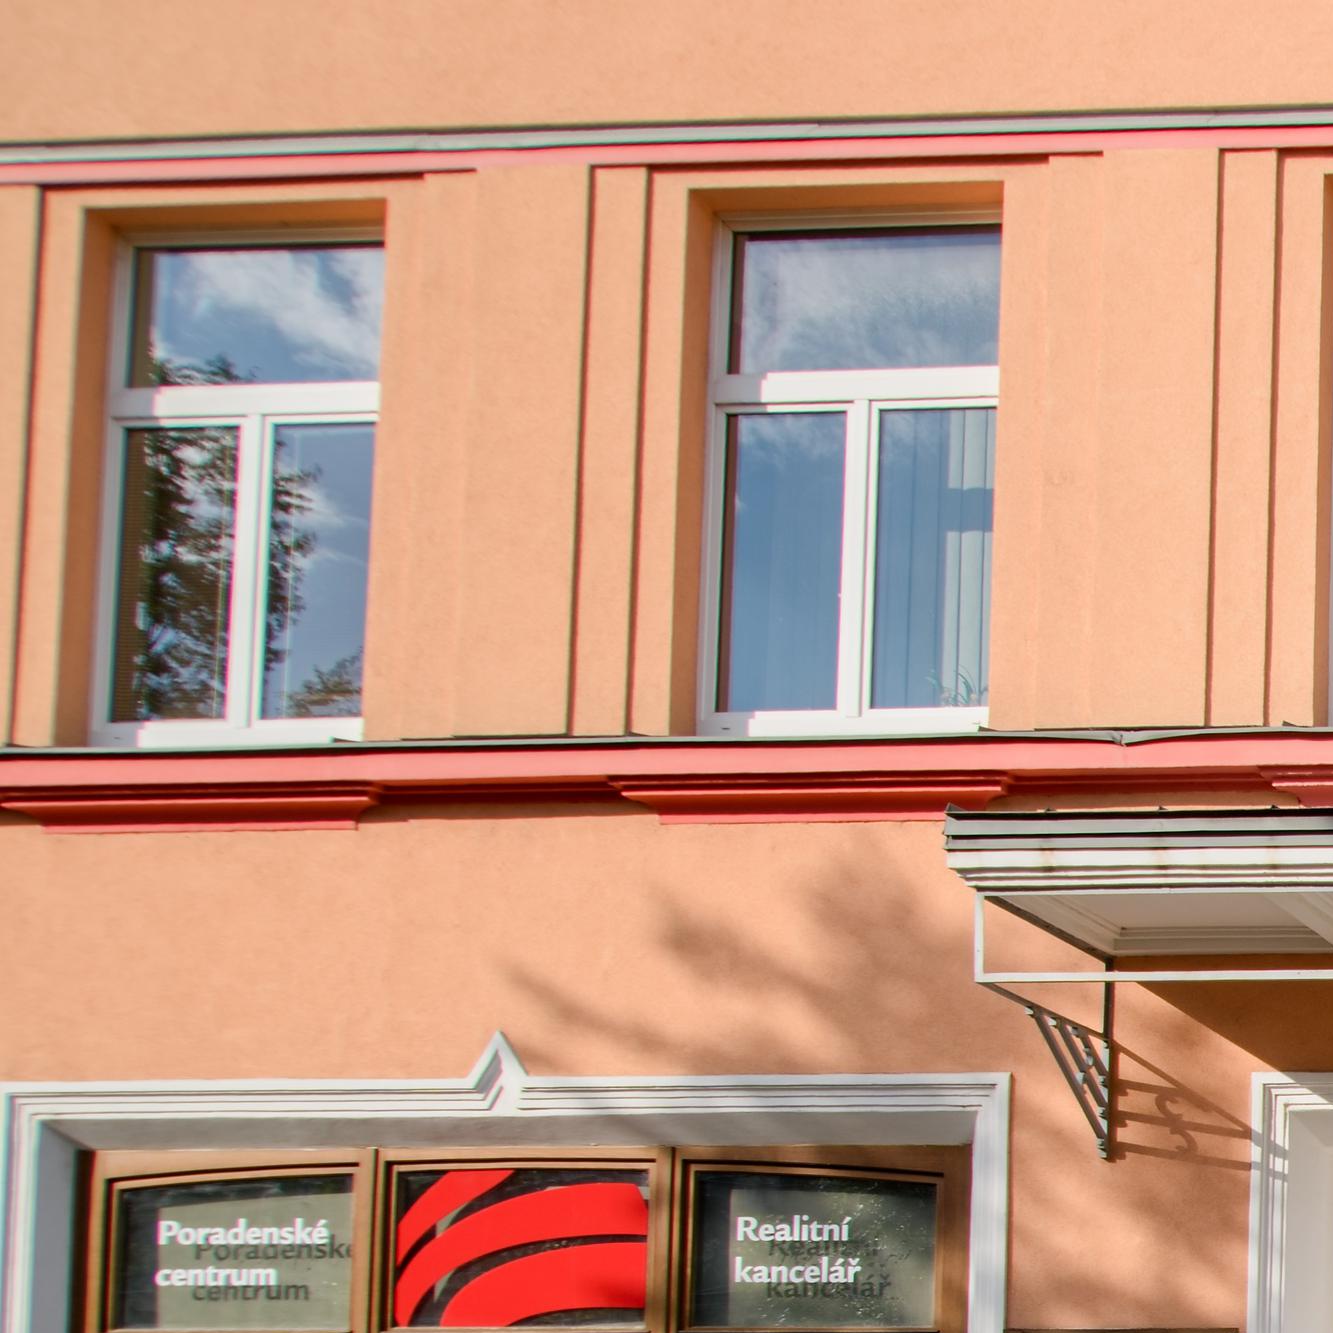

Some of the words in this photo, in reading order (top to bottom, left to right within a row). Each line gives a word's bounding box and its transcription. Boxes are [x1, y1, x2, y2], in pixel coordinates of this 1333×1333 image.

[157, 1217, 331, 1245] Poradenské
[735, 1215, 852, 1241] Realitní
[154, 1265, 278, 1287] centrum
[734, 1256, 862, 1283] kancelář
